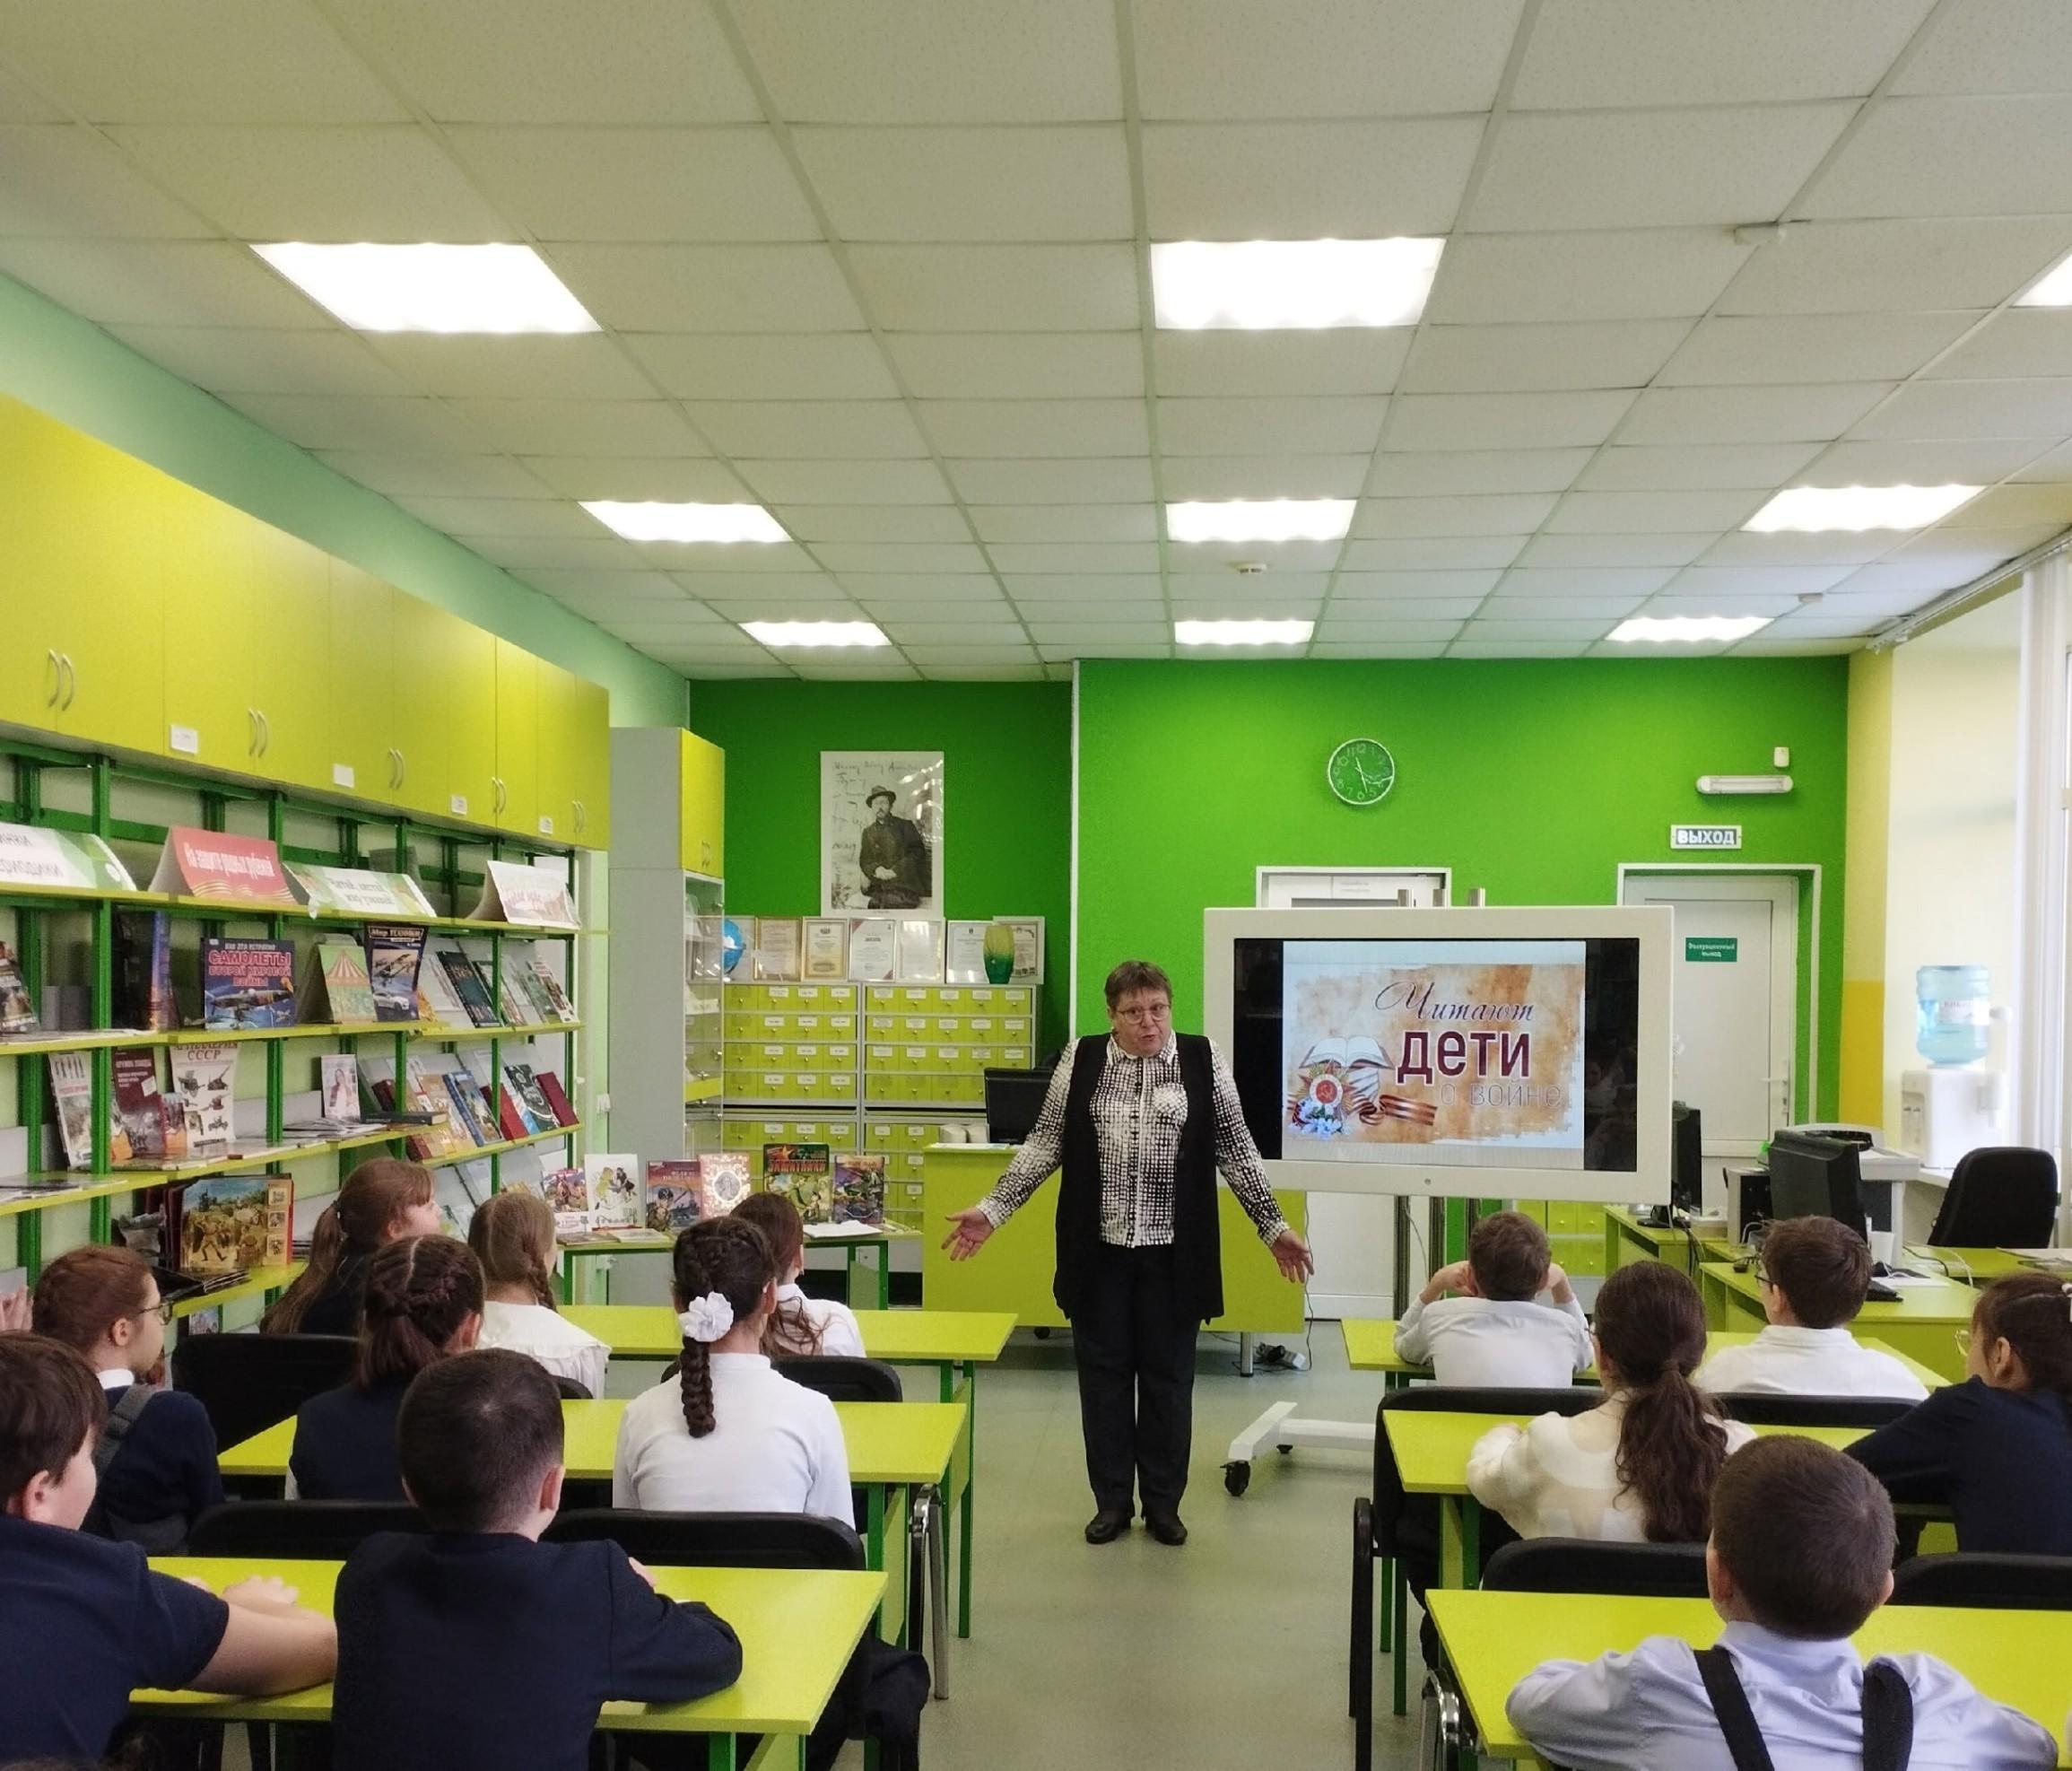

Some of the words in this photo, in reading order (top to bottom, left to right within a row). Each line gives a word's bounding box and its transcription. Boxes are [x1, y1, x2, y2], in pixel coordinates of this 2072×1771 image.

[1677, 830, 1735, 845] ВЫХОД
[209, 950, 292, 966] САМОЛЕТЫ
[1375, 981, 1535, 1021] Читают
[187, 1050, 221, 1060] СССР
[1396, 1030, 1530, 1085] дети
[1470, 1079, 1561, 1106] войне
